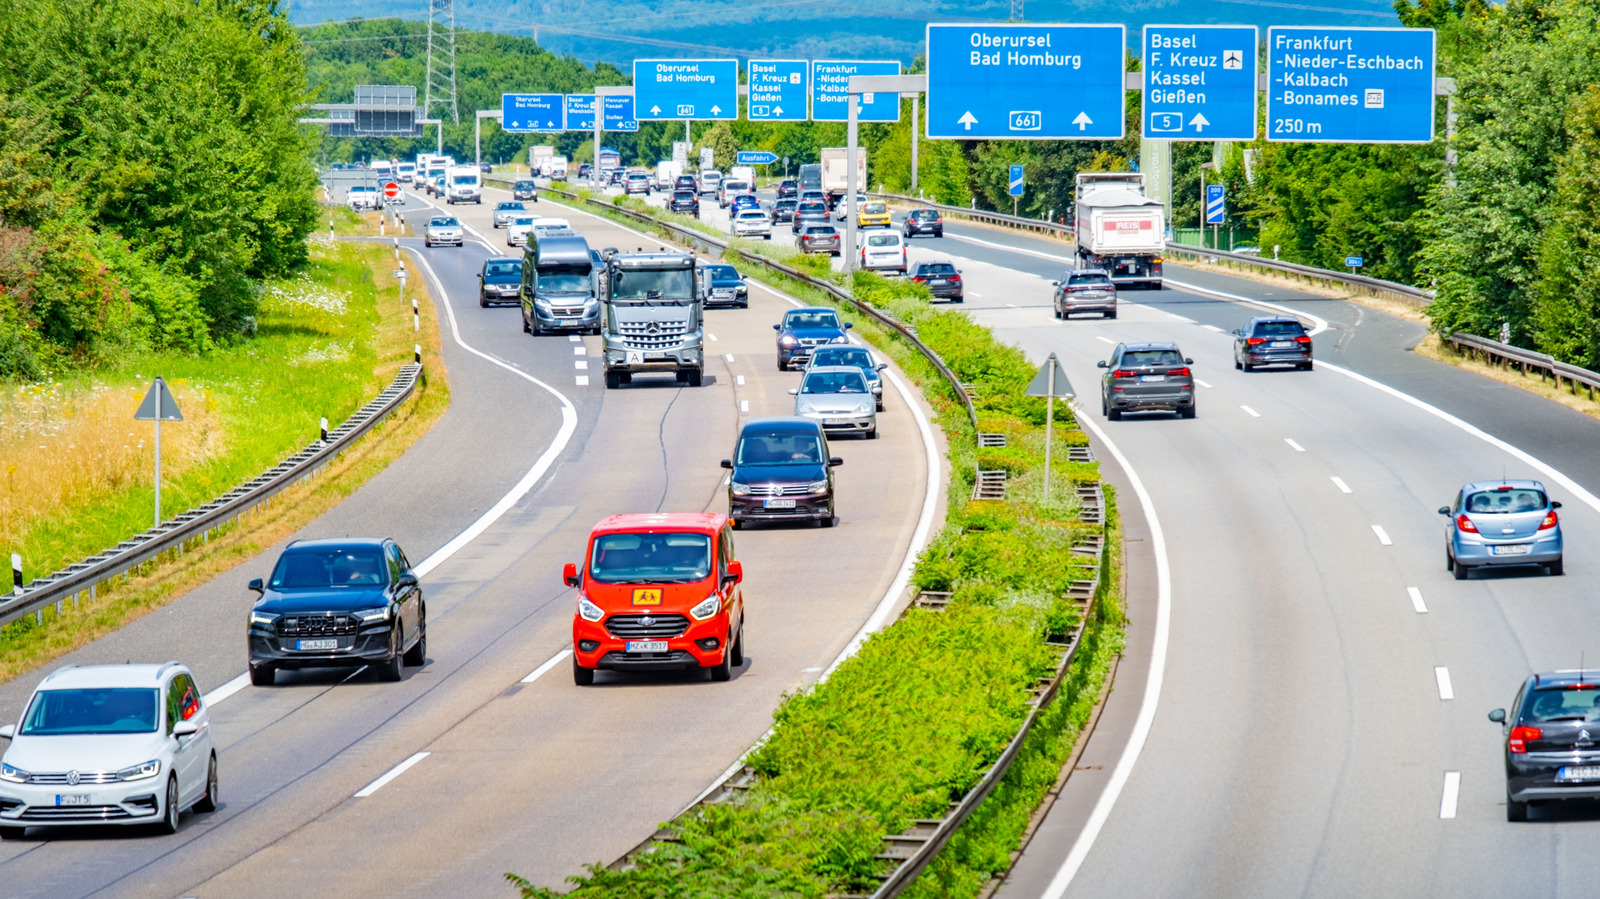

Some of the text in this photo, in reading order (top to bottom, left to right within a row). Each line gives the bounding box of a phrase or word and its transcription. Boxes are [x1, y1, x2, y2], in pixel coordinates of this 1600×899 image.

[970, 32, 1051, 47] Oberursel
[1151, 34, 1197, 48] Basel
[1276, 35, 1352, 50] Frankfurt
[970, 51, 1081, 69] Bad Homburg
[1151, 52, 1217, 67] F. Kreuz
[1276, 54, 1424, 70] -Nieder-Eschbach
[656, 64, 699, 72] Oberursel
[752, 64, 776, 73] Basel
[816, 65, 857, 74] Frankfurt
[656, 74, 715, 84] Bad Homburg
[752, 74, 787, 82] F. Kreuz
[816, 75, 849, 83] -Nieder
[1151, 70, 1206, 85] Kassel
[1275, 72, 1348, 87] -Kalbach
[752, 84, 781, 92] Kassel
[816, 84, 849, 92] -Kalbac
[752, 93, 782, 102] Gießen
[1151, 89, 1206, 104] Gießen
[1275, 90, 1359, 106] -Bonames
[680, 106, 692, 114] 661
[1015, 115, 1036, 127] 661
[1163, 116, 1171, 128] 5
[1275, 119, 1322, 133] 250 m
[1117, 222, 1138, 230] REIS
[630, 353, 639, 362] A
